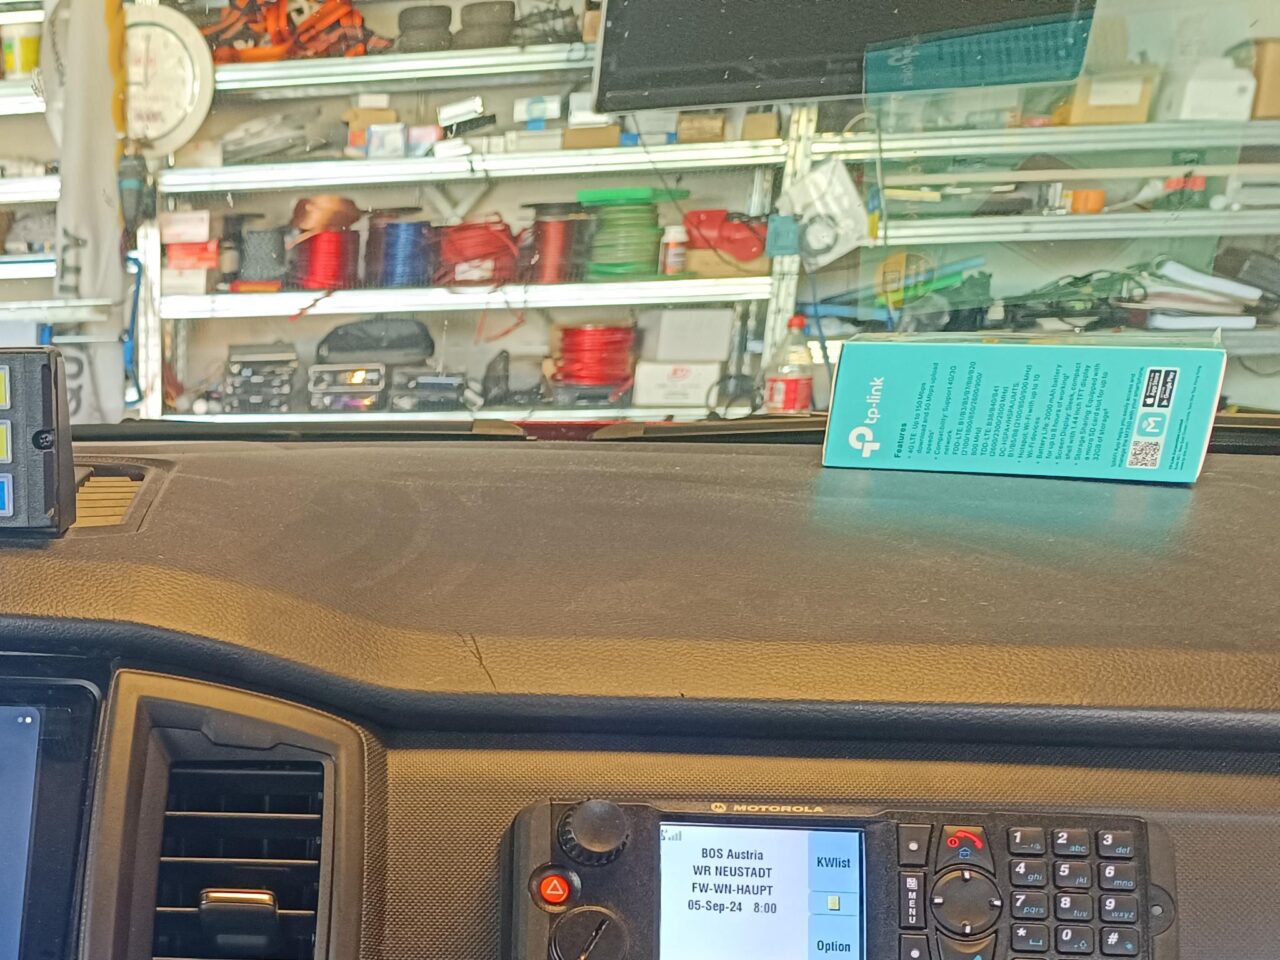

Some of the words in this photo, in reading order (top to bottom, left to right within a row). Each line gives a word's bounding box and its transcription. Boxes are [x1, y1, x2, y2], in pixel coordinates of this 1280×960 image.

[1052, 365, 1062, 387] battery
[1081, 365, 1091, 387] display
[1100, 380, 1107, 388] up
[1164, 383, 1173, 398] Google
[863, 377, 887, 424] tp-link
[943, 387, 953, 411] Support
[1030, 391, 1037, 399] up
[1049, 389, 1057, 403] mAh
[1078, 389, 1086, 400] TFT
[913, 421, 919, 429] Up
[918, 383, 926, 399] Mbps
[1027, 400, 1035, 413] with
[1045, 404, 1053, 420] 2000
[1056, 438, 1065, 460] Screen
[1070, 363, 1081, 390] compact
[1075, 402, 1083, 415] inch
[1075, 436, 1085, 460] Storage
[1086, 378, 1098, 407] Equipped
[1093, 363, 1101, 376] with
[1095, 400, 1103, 411] slot
[1024, 414, 1032, 430] Wi-Fi
[1092, 413, 1100, 426] card
[1048, 441, 1055, 449] up
[1053, 409, 1062, 427] hours
[1090, 428, 1096, 436] SD
[895, 423, 906, 458] Features
[943, 431, 952, 455] network
[1027, 442, 1035, 458] Wi-Fi
[1031, 417, 1040, 441] devices
[1037, 436, 1047, 459] Battery
[1085, 438, 1094, 455] micro
[733, 804, 824, 813] MOTOROLA
[1014, 831, 1021, 842] 1
[1057, 832, 1068, 844] 2
[1103, 834, 1113, 845] 3
[702, 848, 723, 859] BOS
[726, 849, 763, 860] Austria
[817, 857, 851, 868] KWlist
[1015, 862, 1025, 874] 4
[693, 865, 711, 876] WR
[715, 866, 772, 878] NEUSTADT
[1059, 864, 1070, 876] 5
[1105, 866, 1115, 877] 6
[1028, 873, 1042, 881] ghi
[692, 883, 773, 896] FW-WN-HAUPT
[688, 900, 742, 913] 05-Sep-24
[753, 902, 777, 914] 8:00
[1015, 895, 1025, 906] 7
[1060, 897, 1071, 908] 8
[1105, 899, 1115, 910] 9
[908, 891, 917, 924] MENU
[1023, 906, 1044, 914] pqrs
[1062, 929, 1072, 940] 0
[817, 940, 851, 953] Option
